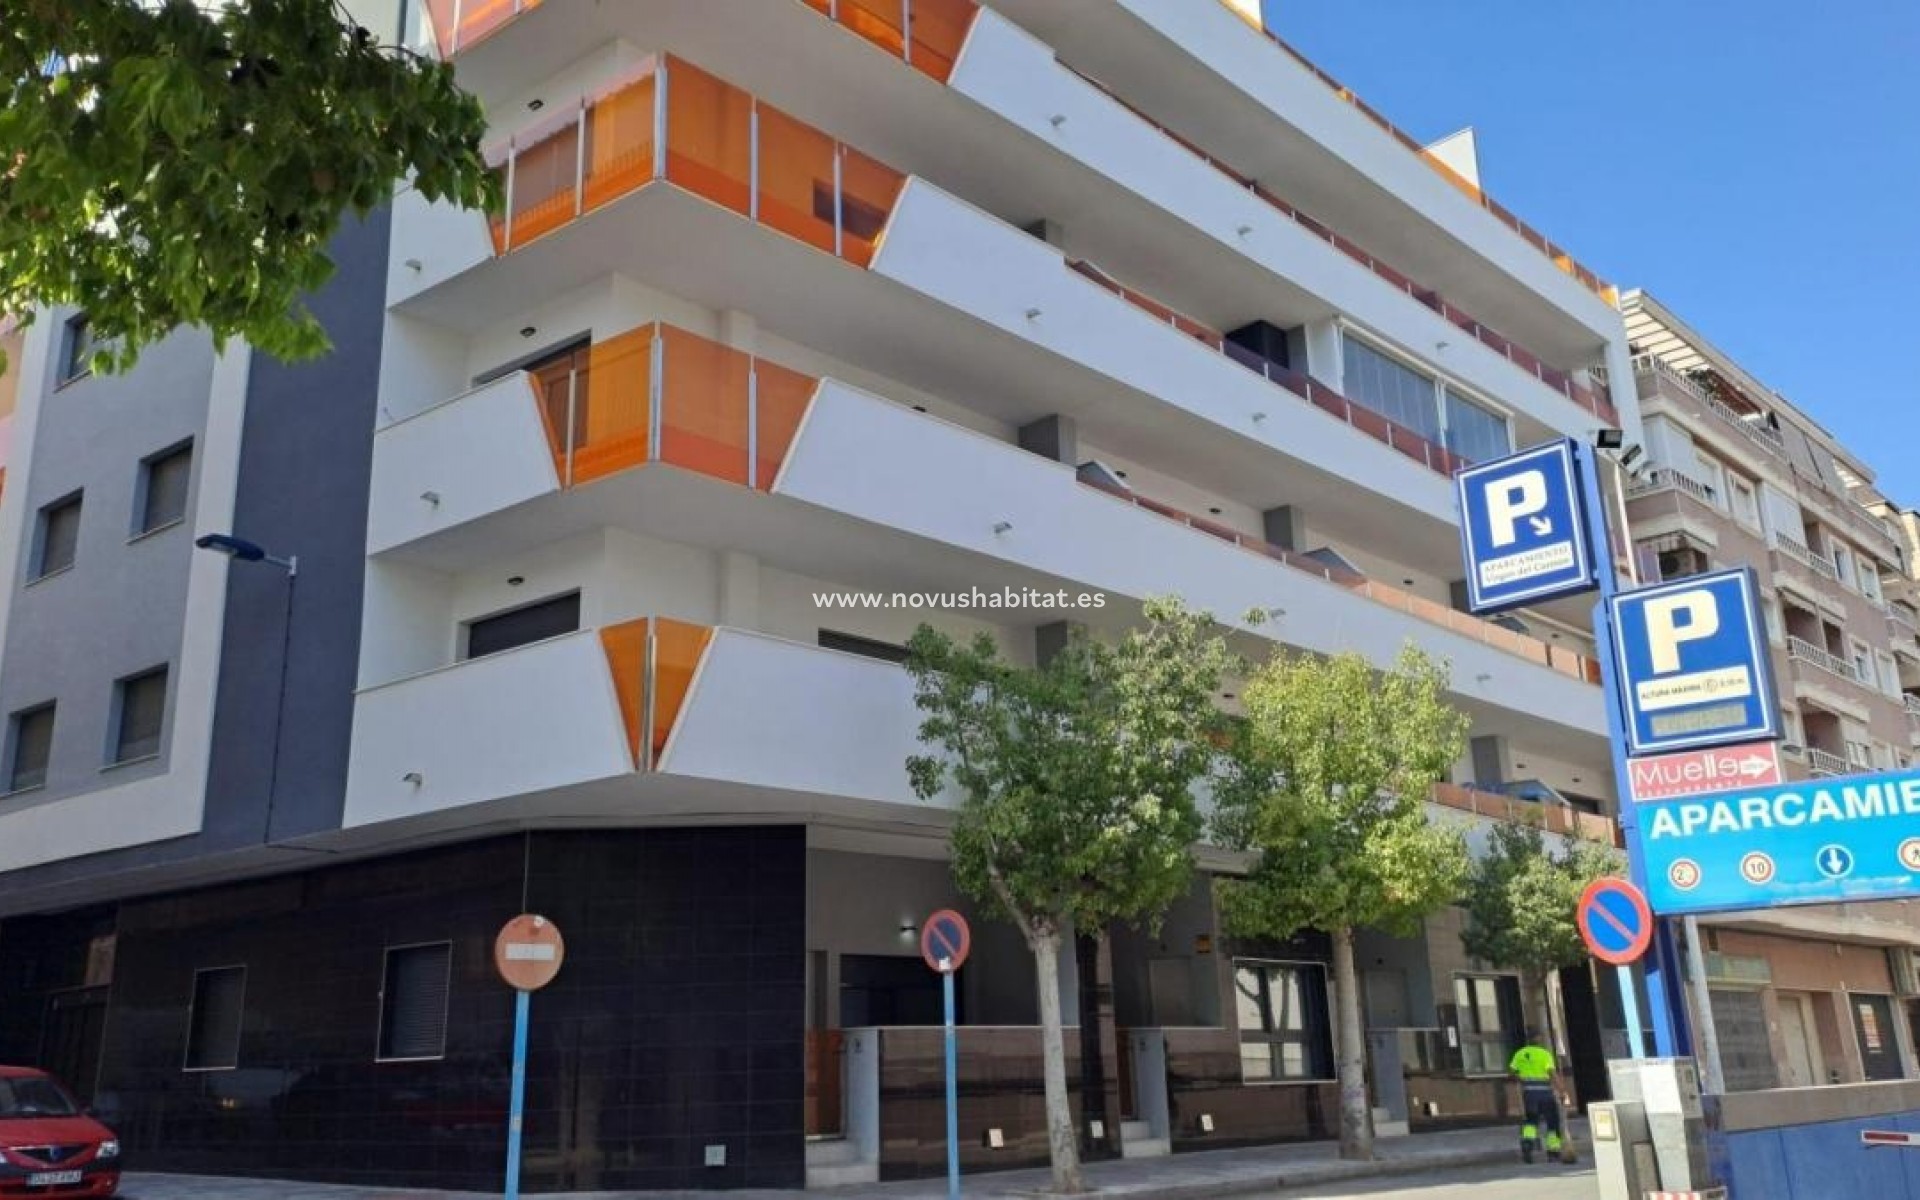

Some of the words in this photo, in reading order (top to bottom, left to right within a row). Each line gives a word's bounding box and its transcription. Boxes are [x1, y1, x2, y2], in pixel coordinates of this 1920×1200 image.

[1485, 470, 1548, 548] P
[1644, 589, 1719, 674] P
[1635, 754, 1738, 788] Muelle
